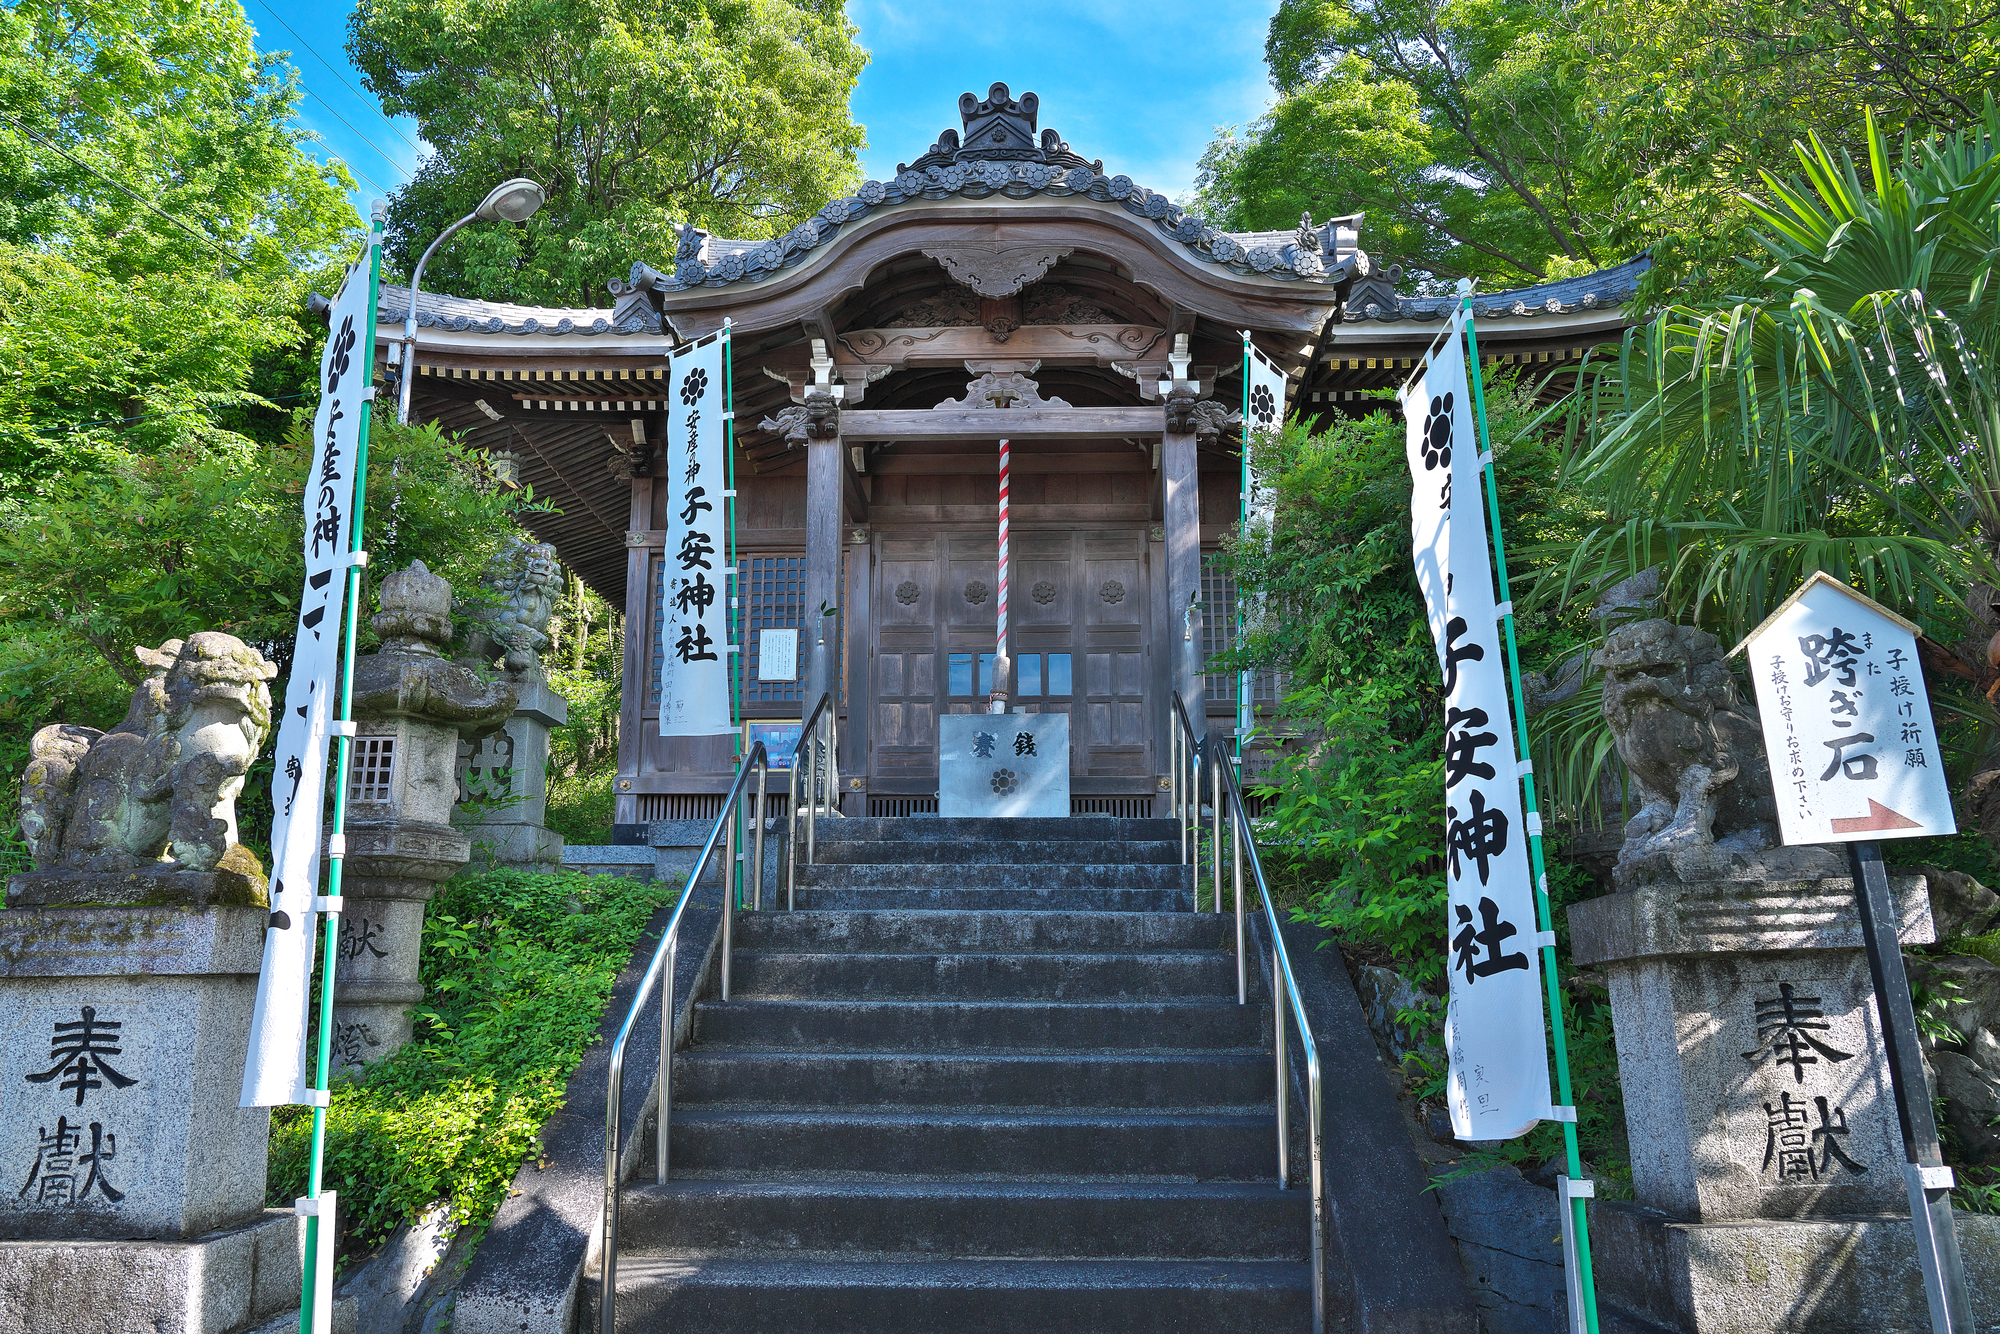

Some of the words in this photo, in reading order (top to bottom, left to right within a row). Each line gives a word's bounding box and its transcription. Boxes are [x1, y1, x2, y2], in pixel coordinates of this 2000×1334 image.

[676, 486, 718, 664] 子安神社
[1862, 631, 1882, 676] また
[1769, 654, 1814, 820] 子授けお守りお求め下さい
[1797, 626, 1879, 782] 跨ぎ石
[1885, 648, 1928, 769] 子授け祈願
[1444, 615, 1529, 986] 子安神社
